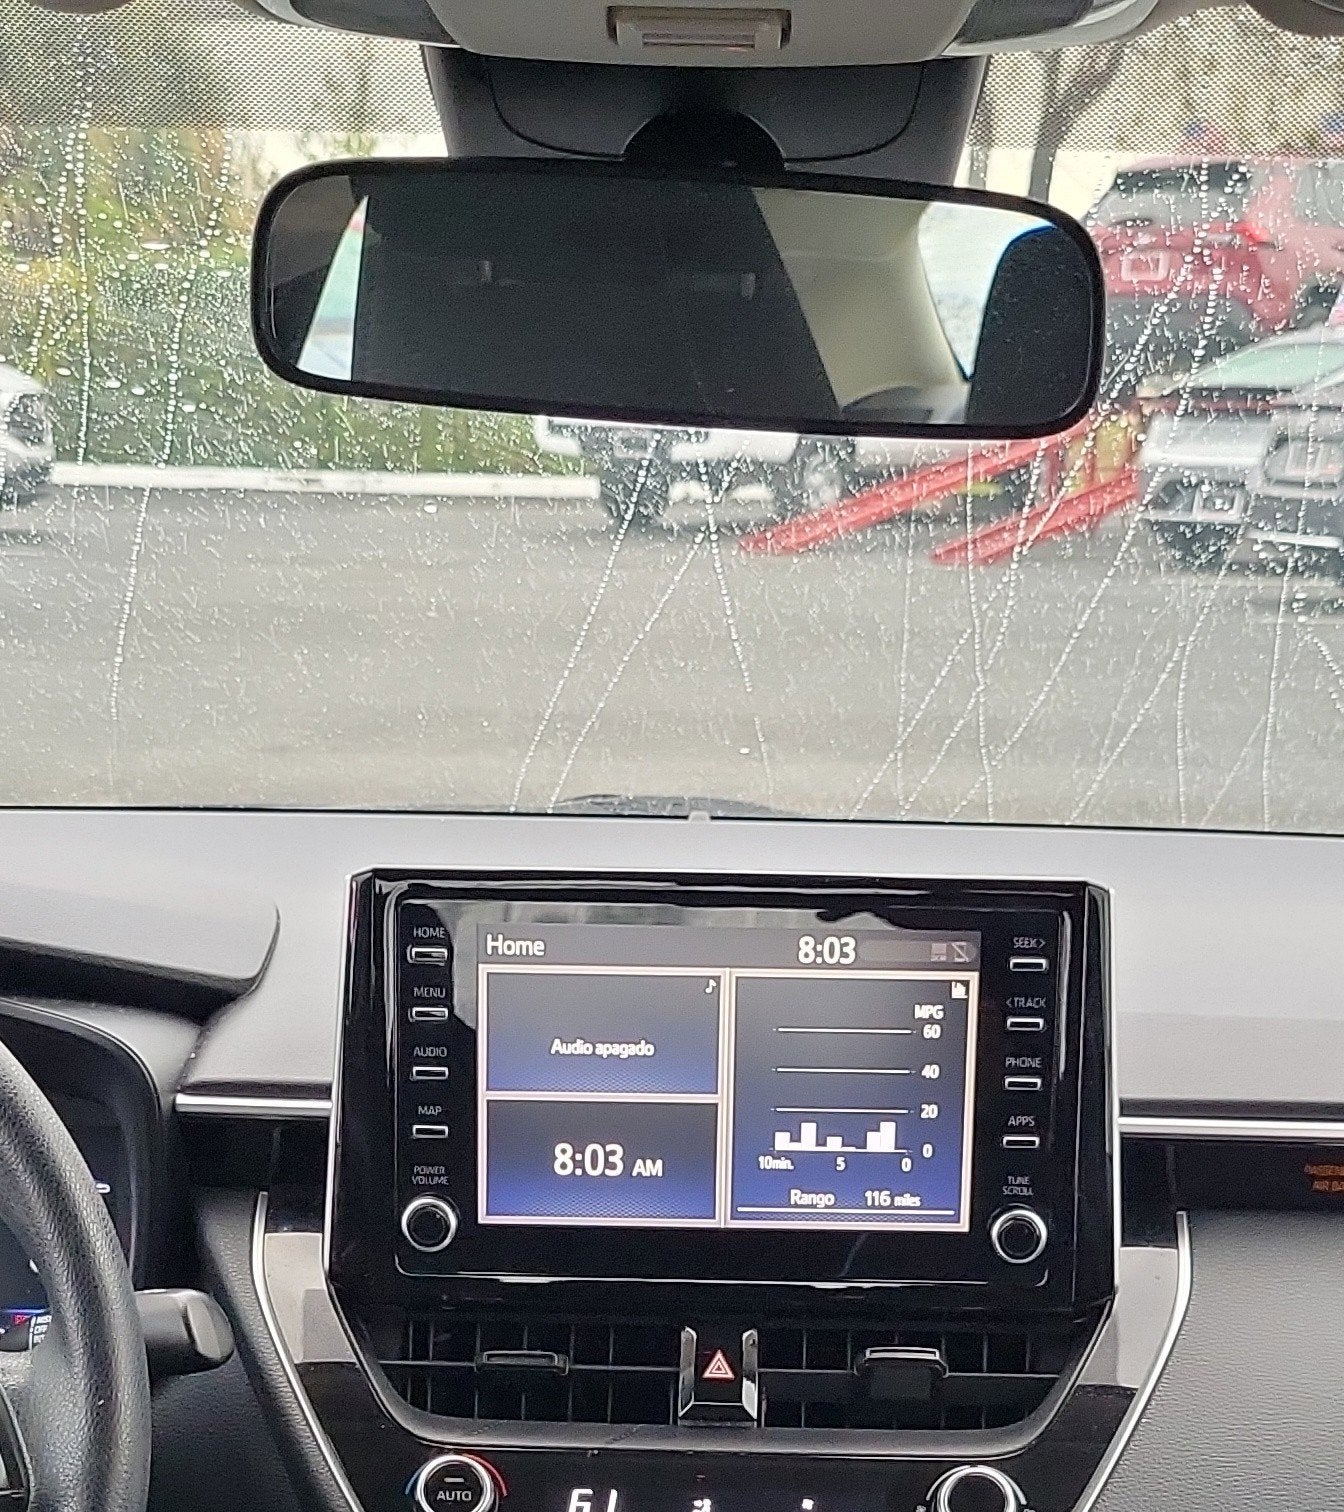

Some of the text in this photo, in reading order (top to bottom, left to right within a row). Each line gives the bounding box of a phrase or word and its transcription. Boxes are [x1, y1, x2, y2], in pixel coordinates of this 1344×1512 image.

[413, 927, 445, 938] HOME
[485, 934, 545, 956] Home
[797, 936, 856, 964] 8:03
[413, 987, 445, 998] MENU
[914, 1005, 944, 1020] MPG
[923, 1025, 941, 1039] 60
[413, 1046, 447, 1057] AUDIO
[550, 1038, 655, 1058] Audio apagado
[1005, 1057, 1042, 1068] PHONE
[921, 1065, 939, 1079] 40
[418, 1105, 442, 1115] MAP
[920, 1105, 938, 1119] 20
[1008, 1116, 1035, 1127] APPS
[922, 1144, 933, 1158] 0
[554, 1143, 663, 1177] 8:03 AM
[836, 1157, 846, 1171] 5
[901, 1157, 912, 1172] 0
[790, 1190, 835, 1208] Rango
[864, 1191, 890, 1207] 116
[436, 1489, 472, 1502] AUTO
